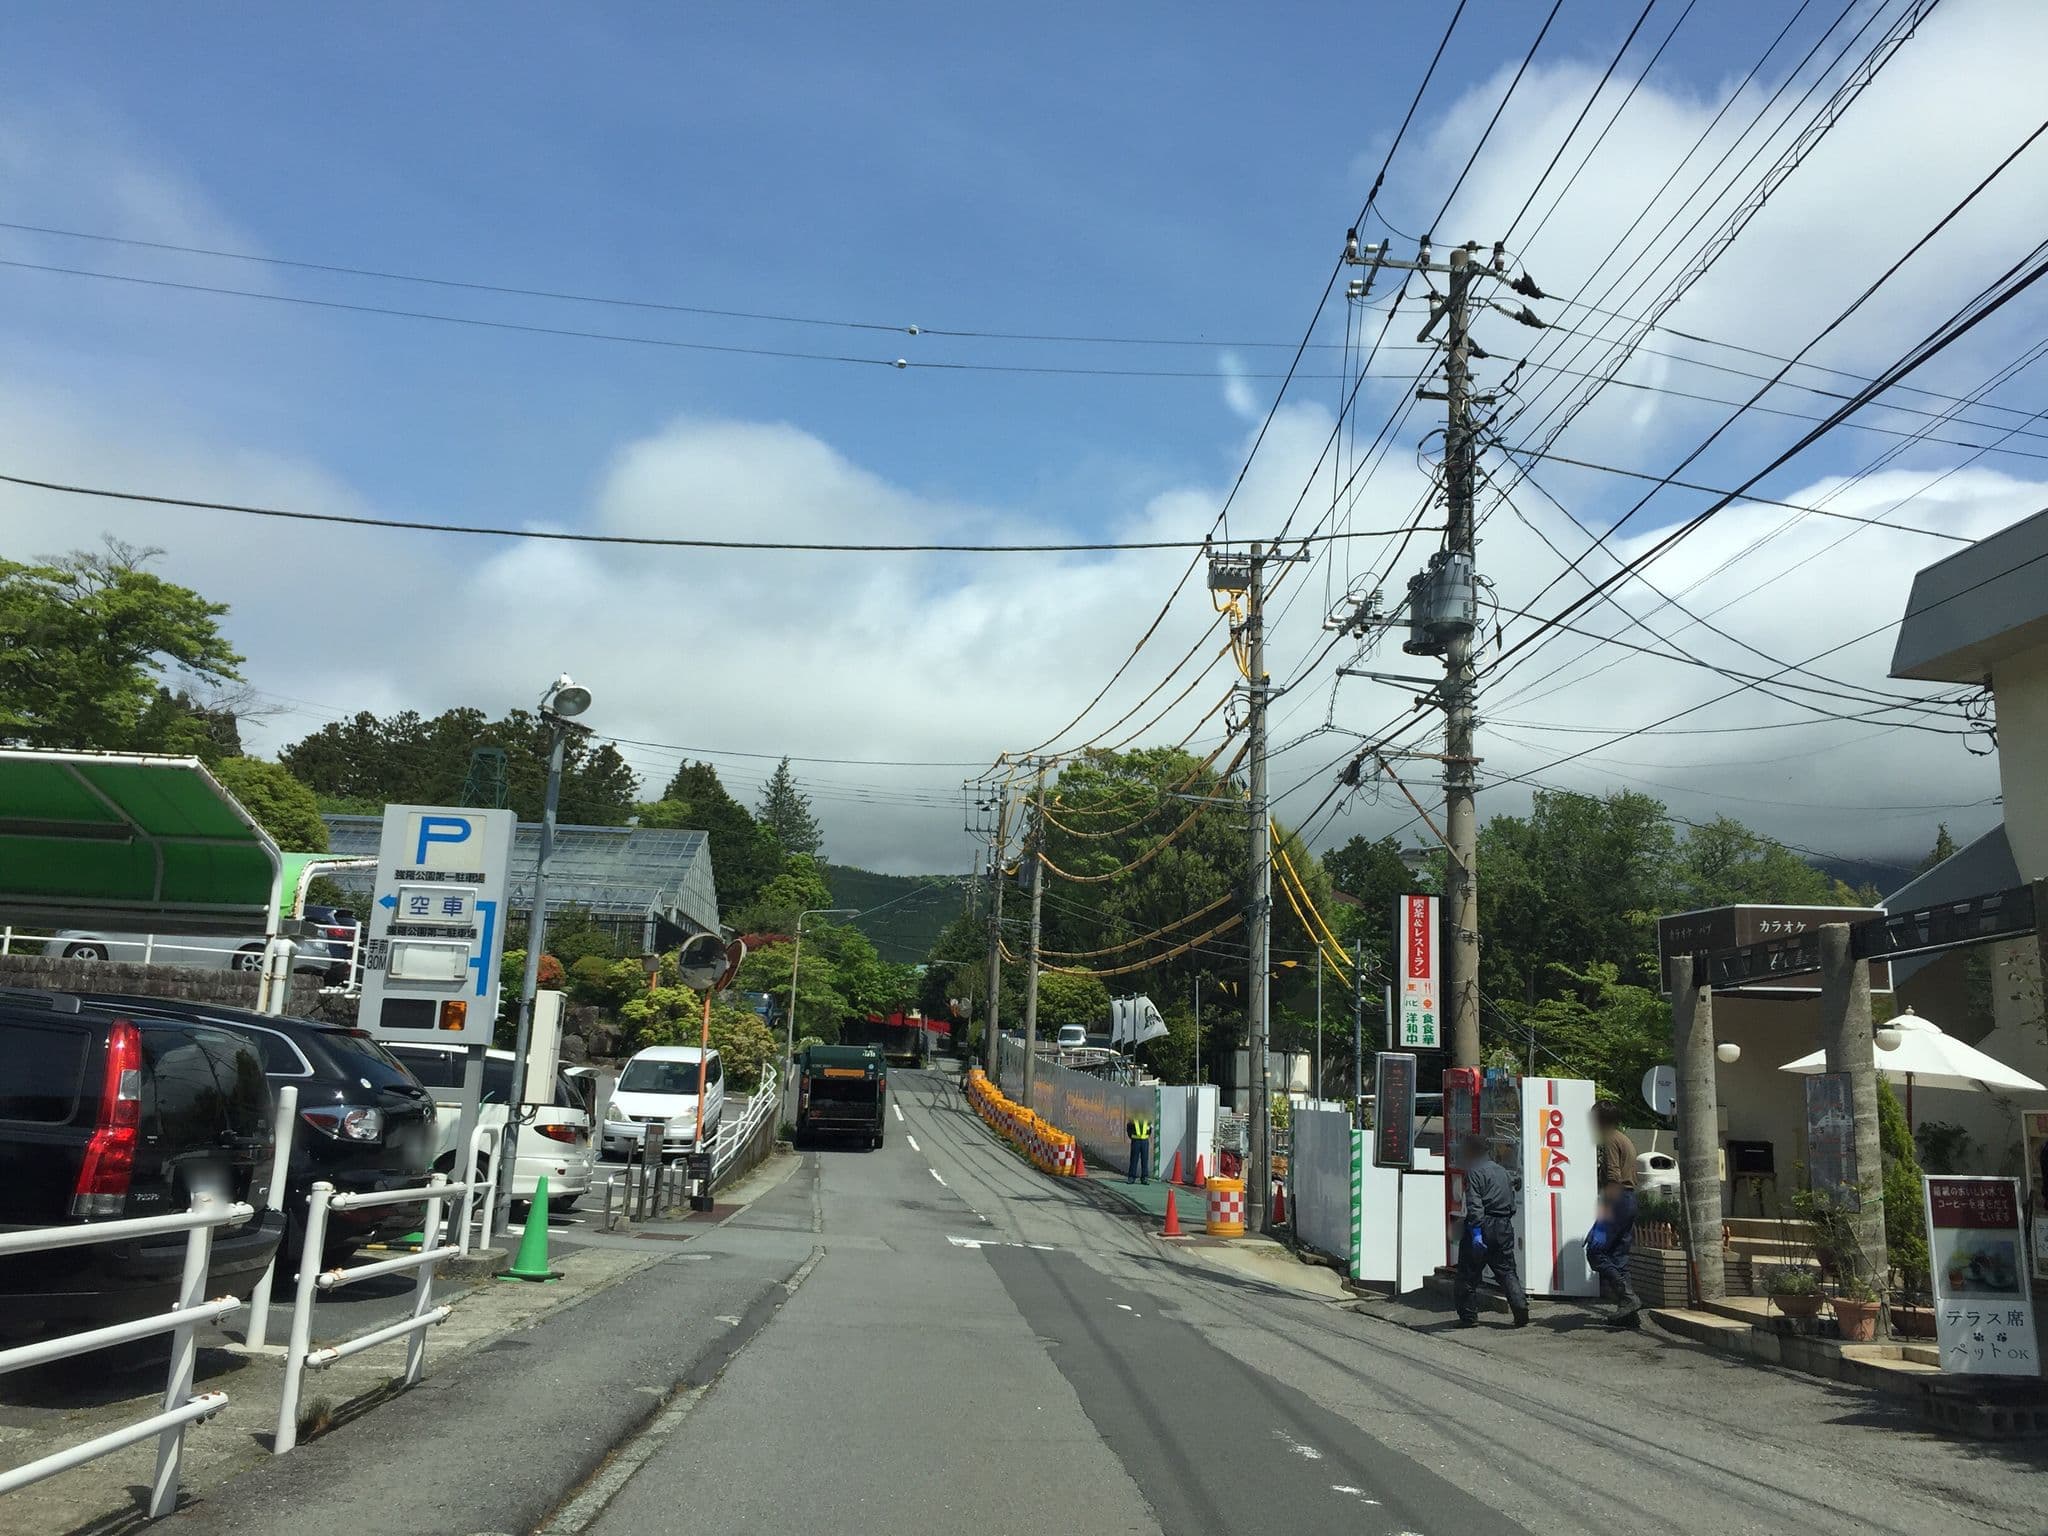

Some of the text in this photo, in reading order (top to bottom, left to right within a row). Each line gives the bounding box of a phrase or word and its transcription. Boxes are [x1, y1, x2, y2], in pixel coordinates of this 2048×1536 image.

[416, 816, 471, 865] P
[1759, 920, 1807, 934] カラオケ
[369, 939, 388, 955] 手前
[367, 955, 386, 970] 30M
[1946, 1310, 2025, 1327] テラス席
